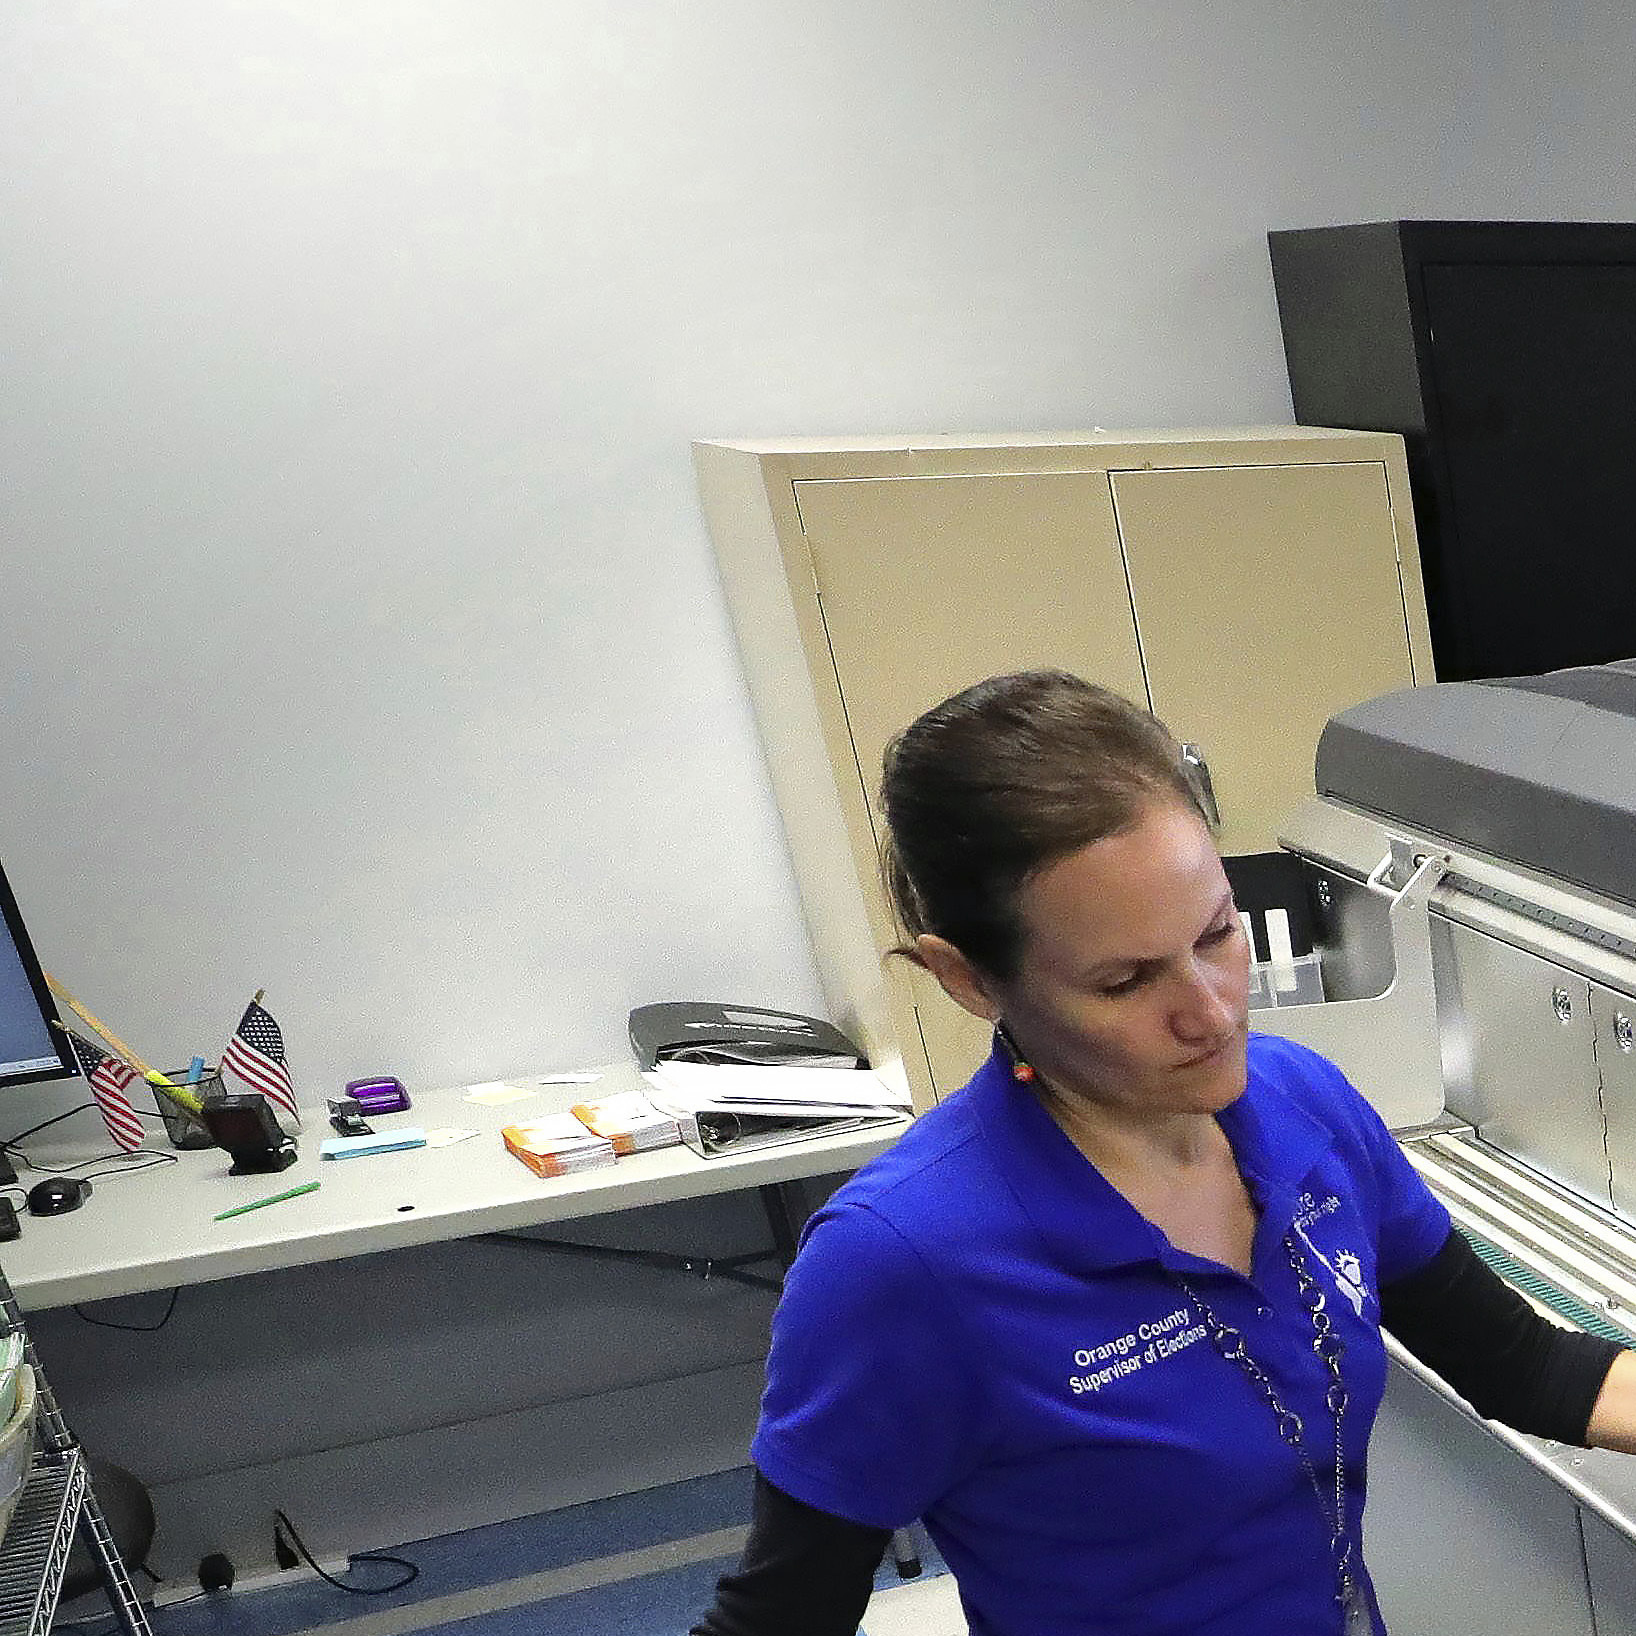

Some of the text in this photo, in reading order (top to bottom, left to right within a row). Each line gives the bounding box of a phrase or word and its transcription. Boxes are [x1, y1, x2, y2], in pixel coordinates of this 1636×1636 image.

[1069, 1324, 1207, 1394] Supervisor of Elections
[1074, 1308, 1189, 1366] Orange County
